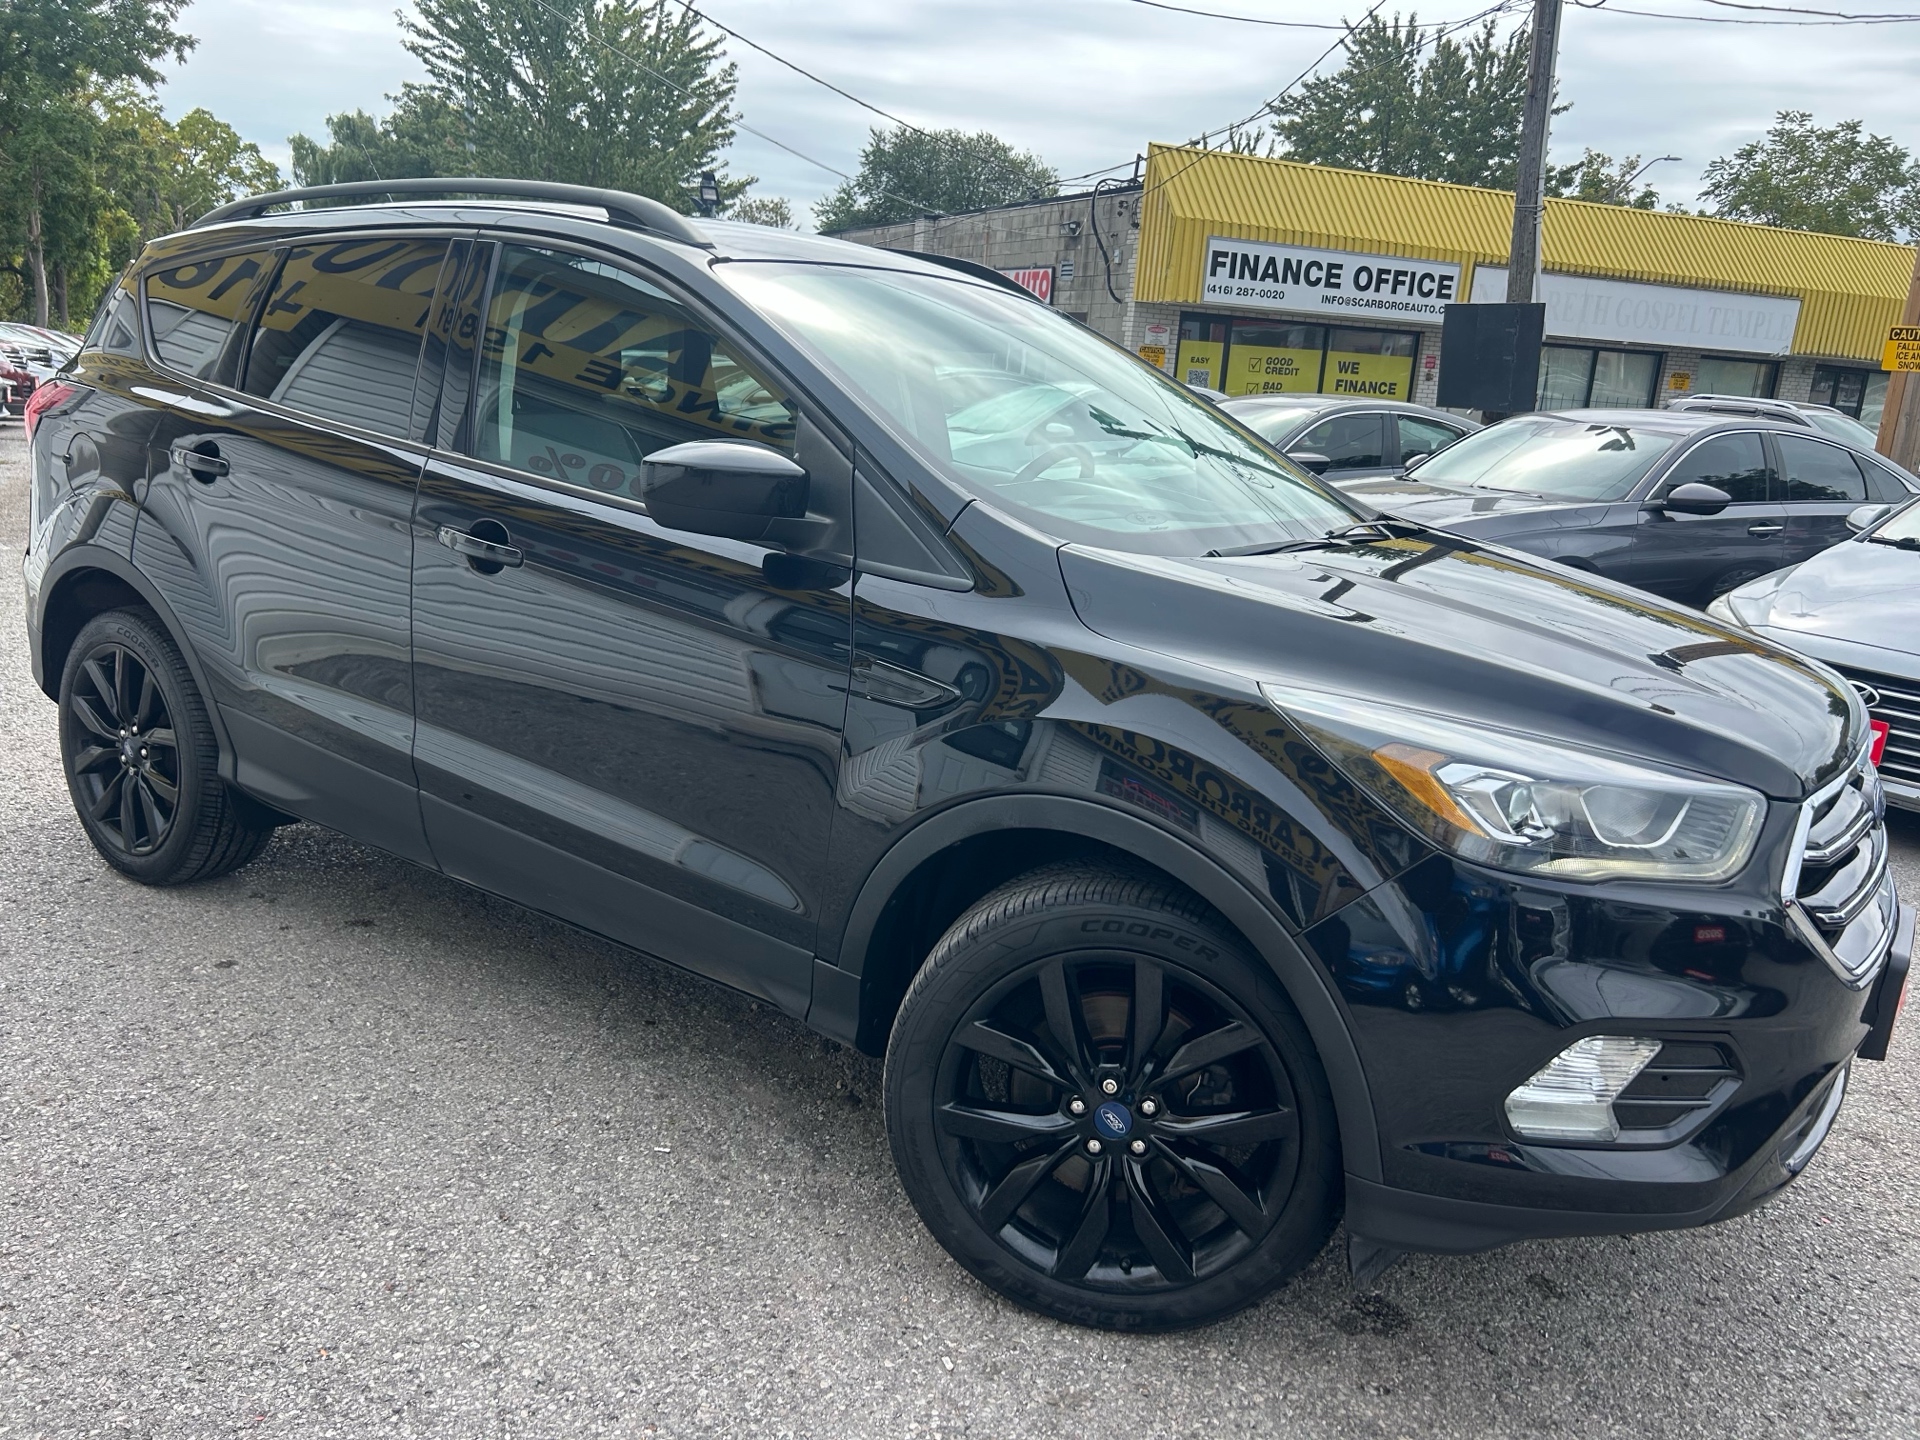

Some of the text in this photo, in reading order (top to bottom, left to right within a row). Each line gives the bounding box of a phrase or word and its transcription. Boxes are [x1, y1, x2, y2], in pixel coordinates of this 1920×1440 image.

[1209, 250, 1455, 300] FINANCE OFFICE
[1207, 284, 1285, 300] (416) 287-0020
[1265, 357, 1294, 367] GOOD
[1338, 360, 1360, 375] WE
[1264, 366, 1300, 376] CREDIT
[1262, 382, 1283, 391] BAD
[1335, 379, 1397, 395] FINANCE
[117, 627, 160, 668] COOPER
[1081, 920, 1220, 962] COOPER
